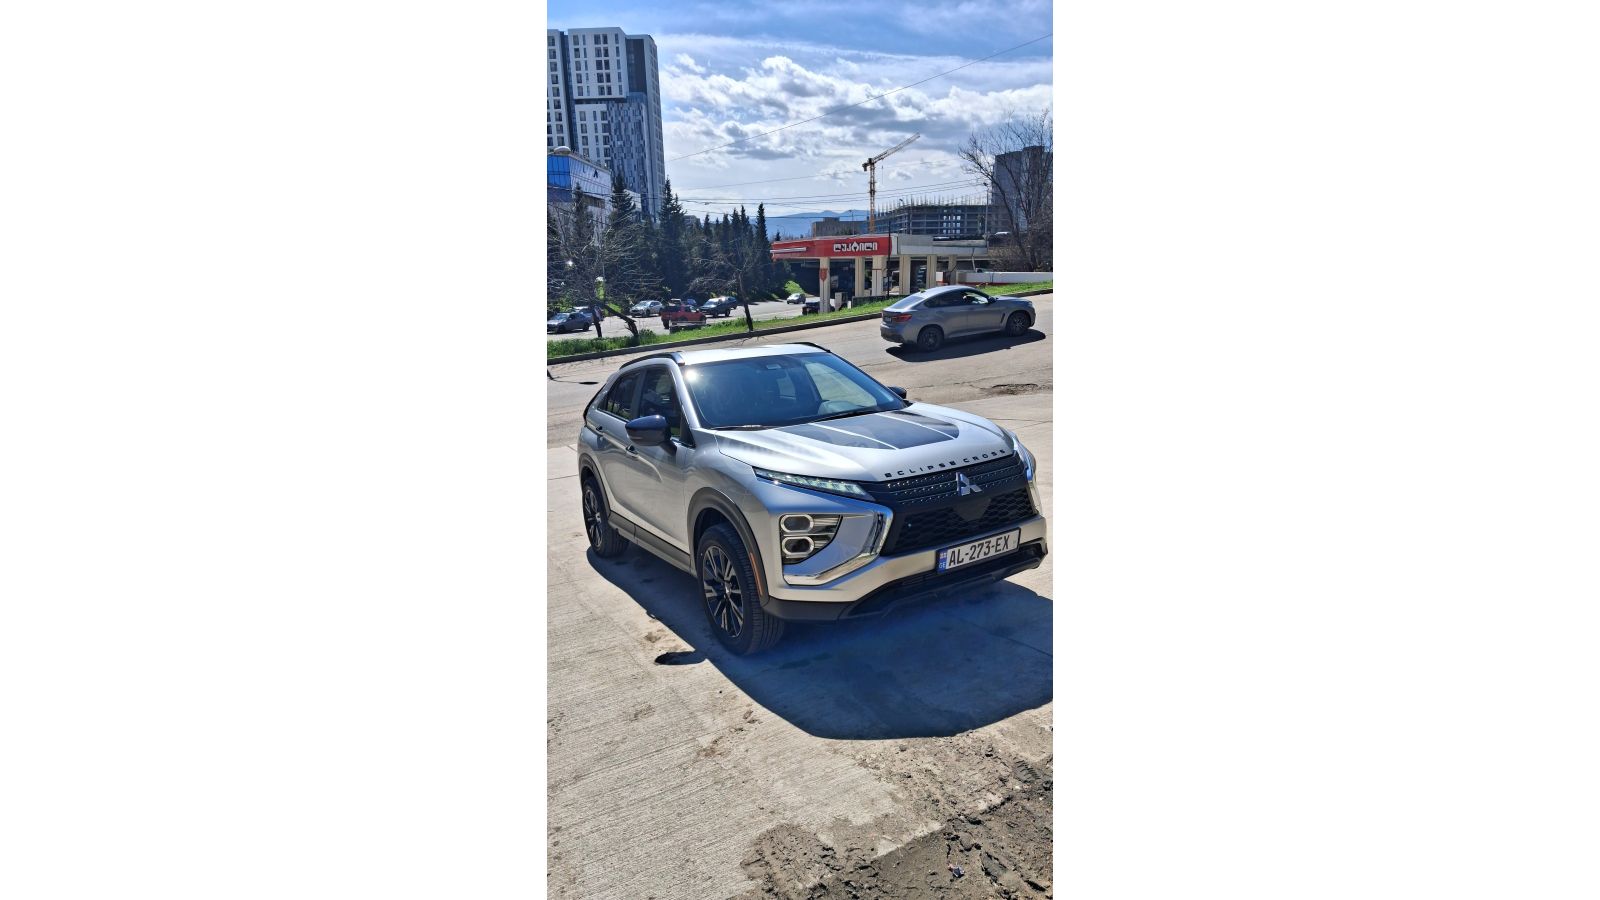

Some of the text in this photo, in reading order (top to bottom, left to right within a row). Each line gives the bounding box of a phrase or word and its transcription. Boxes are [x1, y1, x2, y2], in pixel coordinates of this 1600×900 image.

[884, 449, 1006, 478] ECLIPSE CROSS
[948, 534, 1010, 567] AL-273-EX
